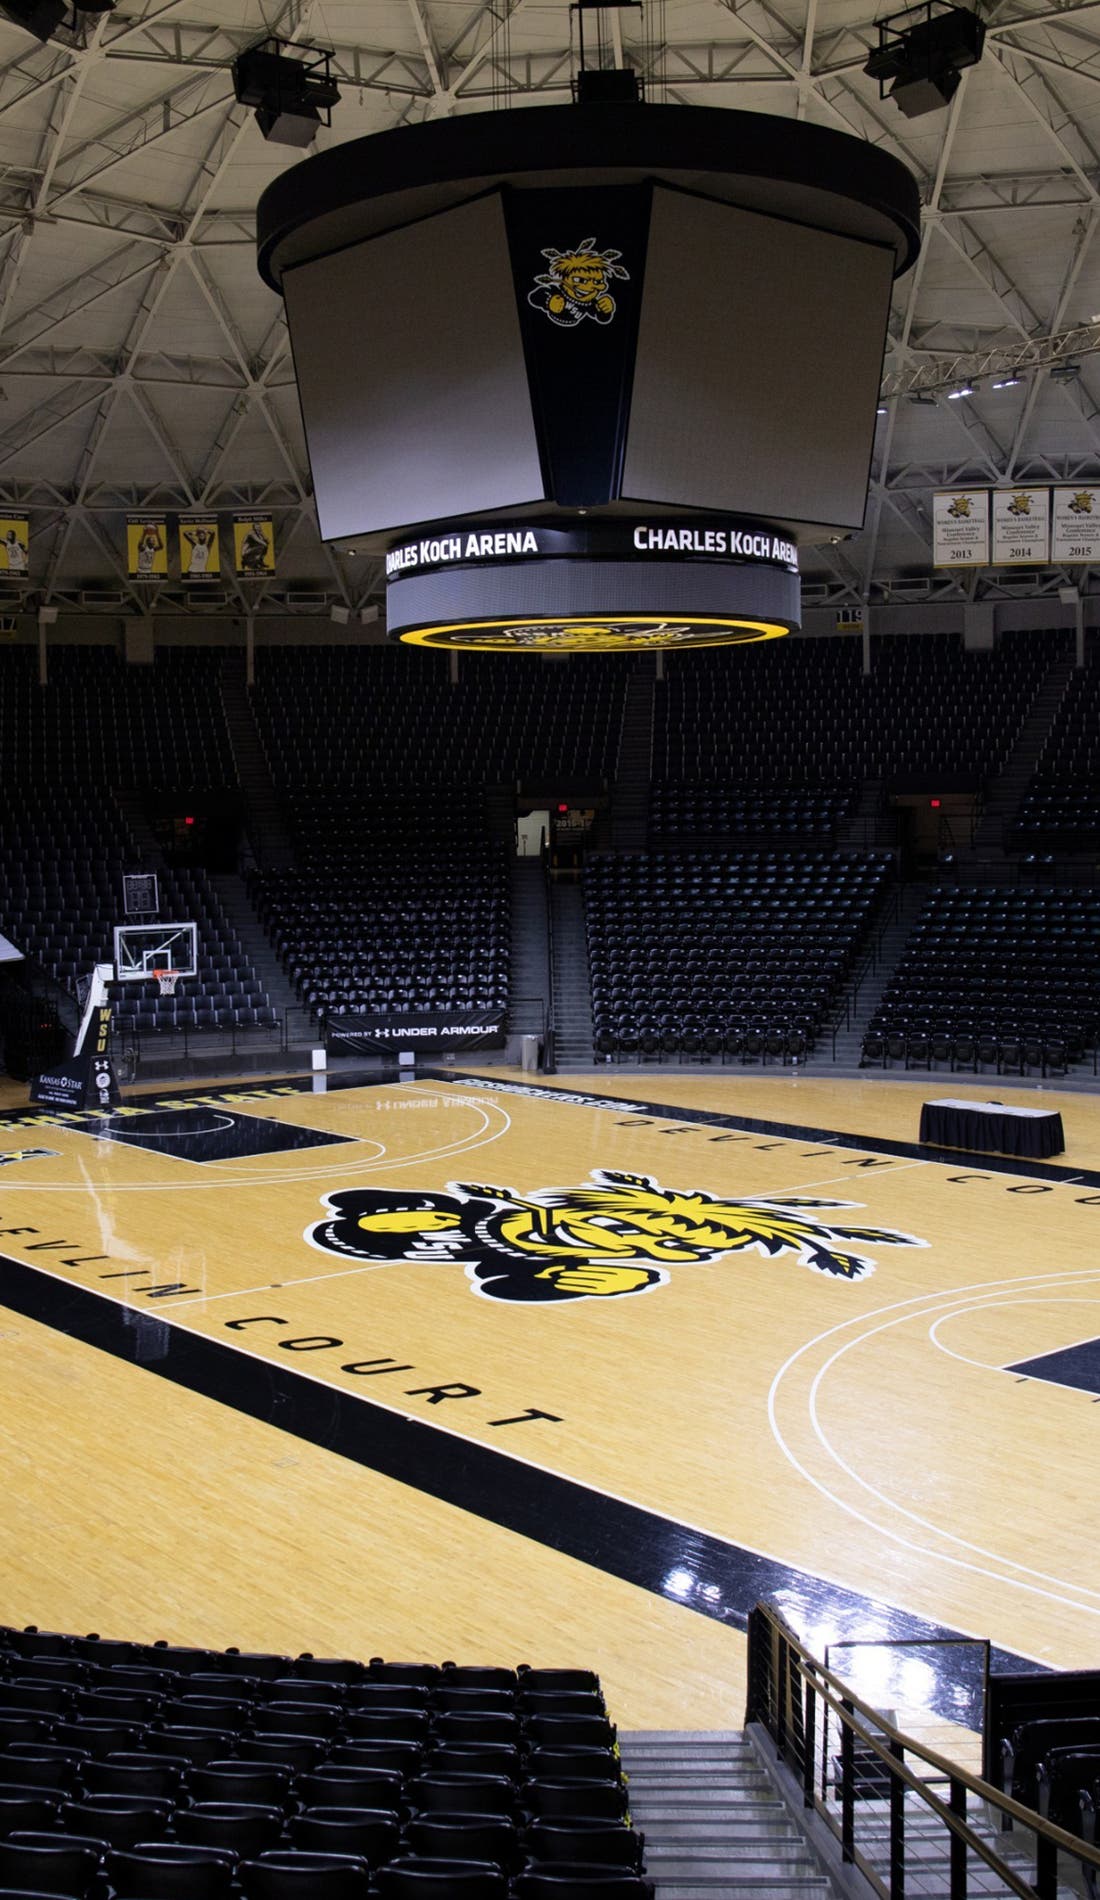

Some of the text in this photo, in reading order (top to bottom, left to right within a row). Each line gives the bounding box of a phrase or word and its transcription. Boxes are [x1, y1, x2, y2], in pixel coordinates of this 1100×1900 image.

[565, 301, 582, 319] WSU
[420, 537, 461, 564] KOCH
[465, 531, 538, 558] ARENA
[633, 526, 726, 553] CHARLES
[731, 531, 769, 558] KOCH
[1009, 547, 1032, 558] 2014
[1068, 546, 1092, 556] 2015
[950, 550, 972, 560] 2013
[837, 609, 865, 624] 119
[97, 1008, 112, 1052] WSU
[392, 1027, 437, 1037] UNDER
[440, 1025, 499, 1035] ARMOUR
[40, 1074, 61, 1086] KANSAS
[67, 1078, 83, 1090] STAR
[156, 1086, 302, 1110] STATE
[612, 1119, 895, 1169] DEVLIN
[402, 1229, 473, 1260] WSU
[0, 1216, 565, 1426] EVLIN COURT
